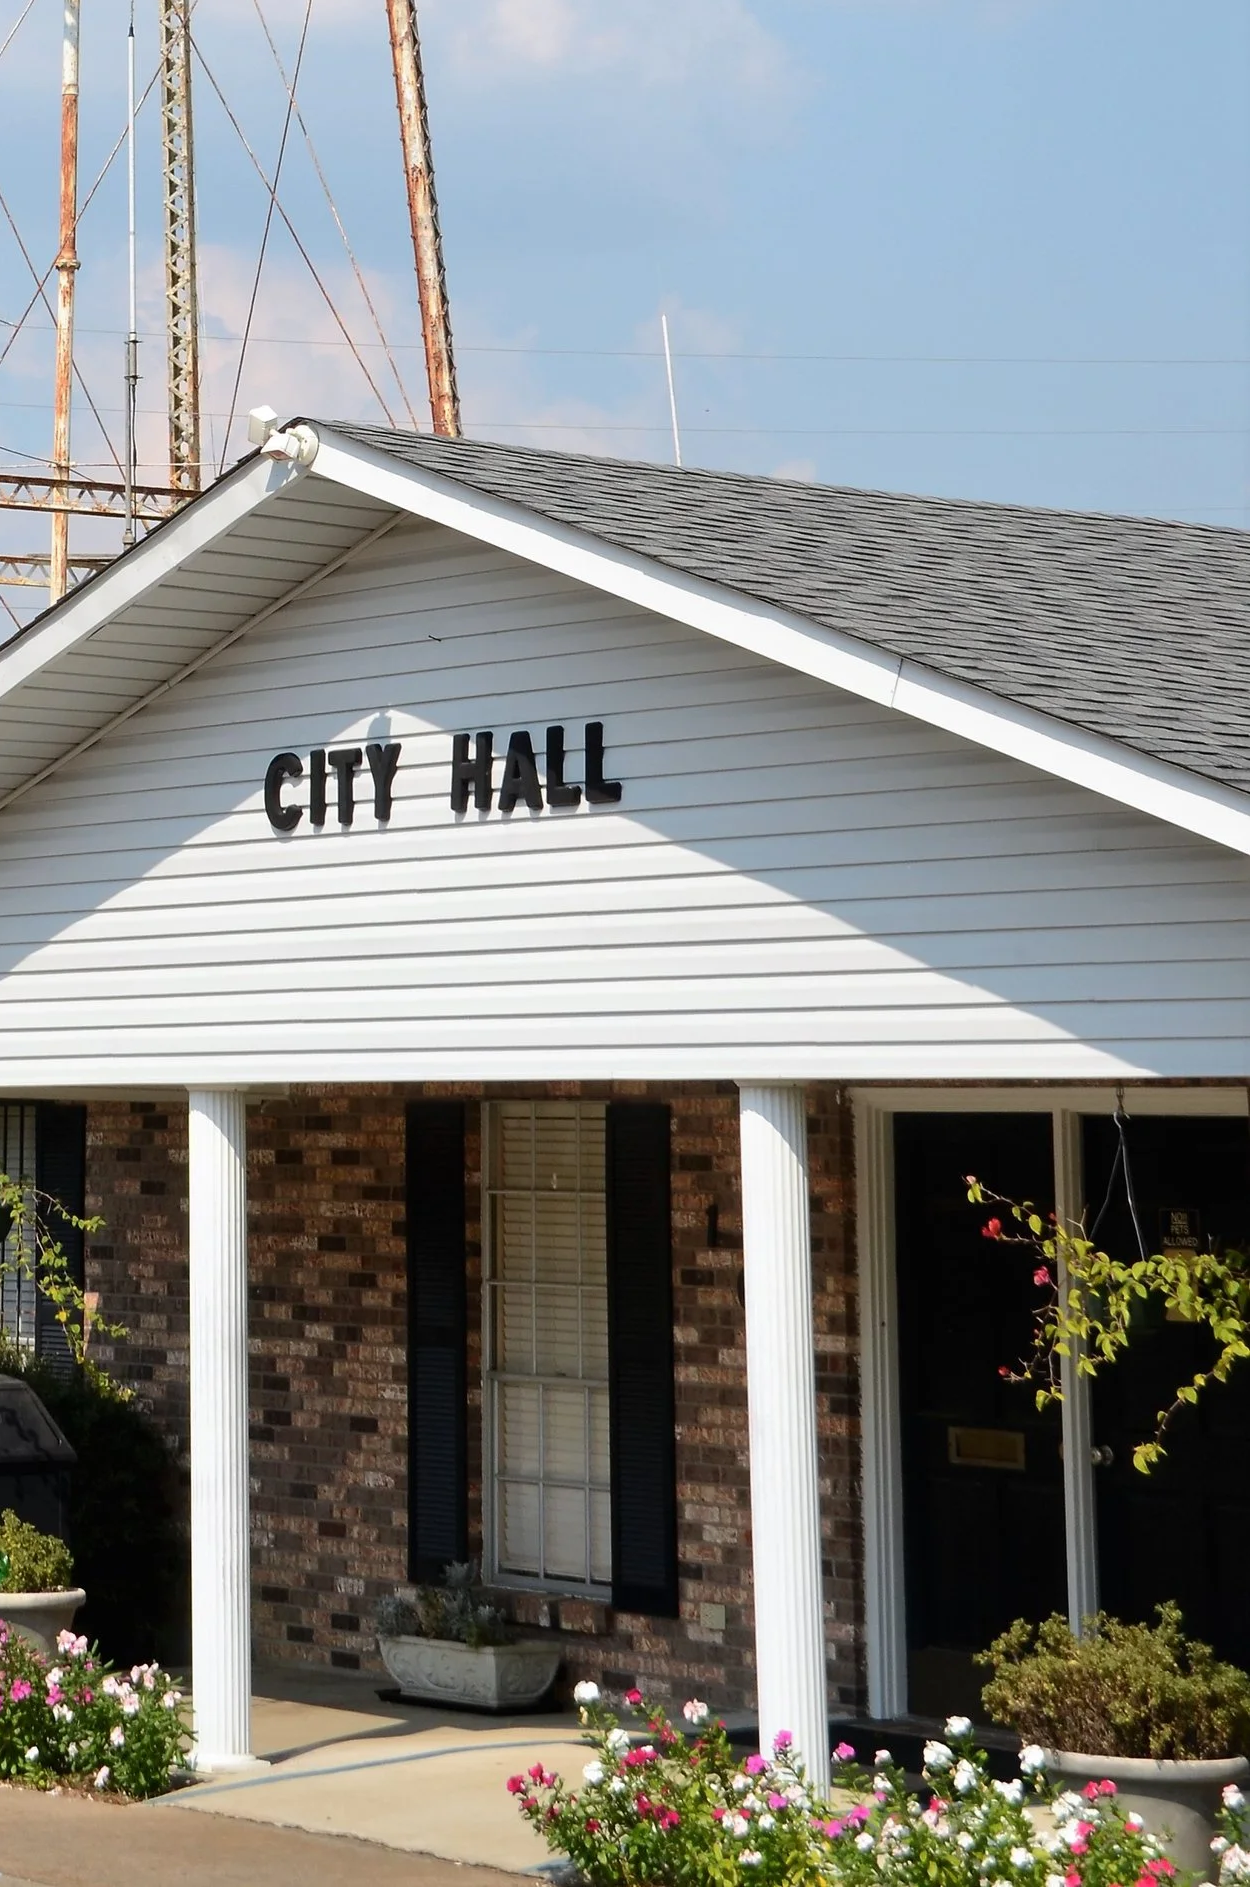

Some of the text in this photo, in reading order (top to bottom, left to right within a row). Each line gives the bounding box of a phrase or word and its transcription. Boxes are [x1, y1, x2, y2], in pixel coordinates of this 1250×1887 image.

[264, 721, 622, 832] CITY HALL
[1170, 1224, 1190, 1235] PETS
[1163, 1236, 1199, 1247] ALLOWED
